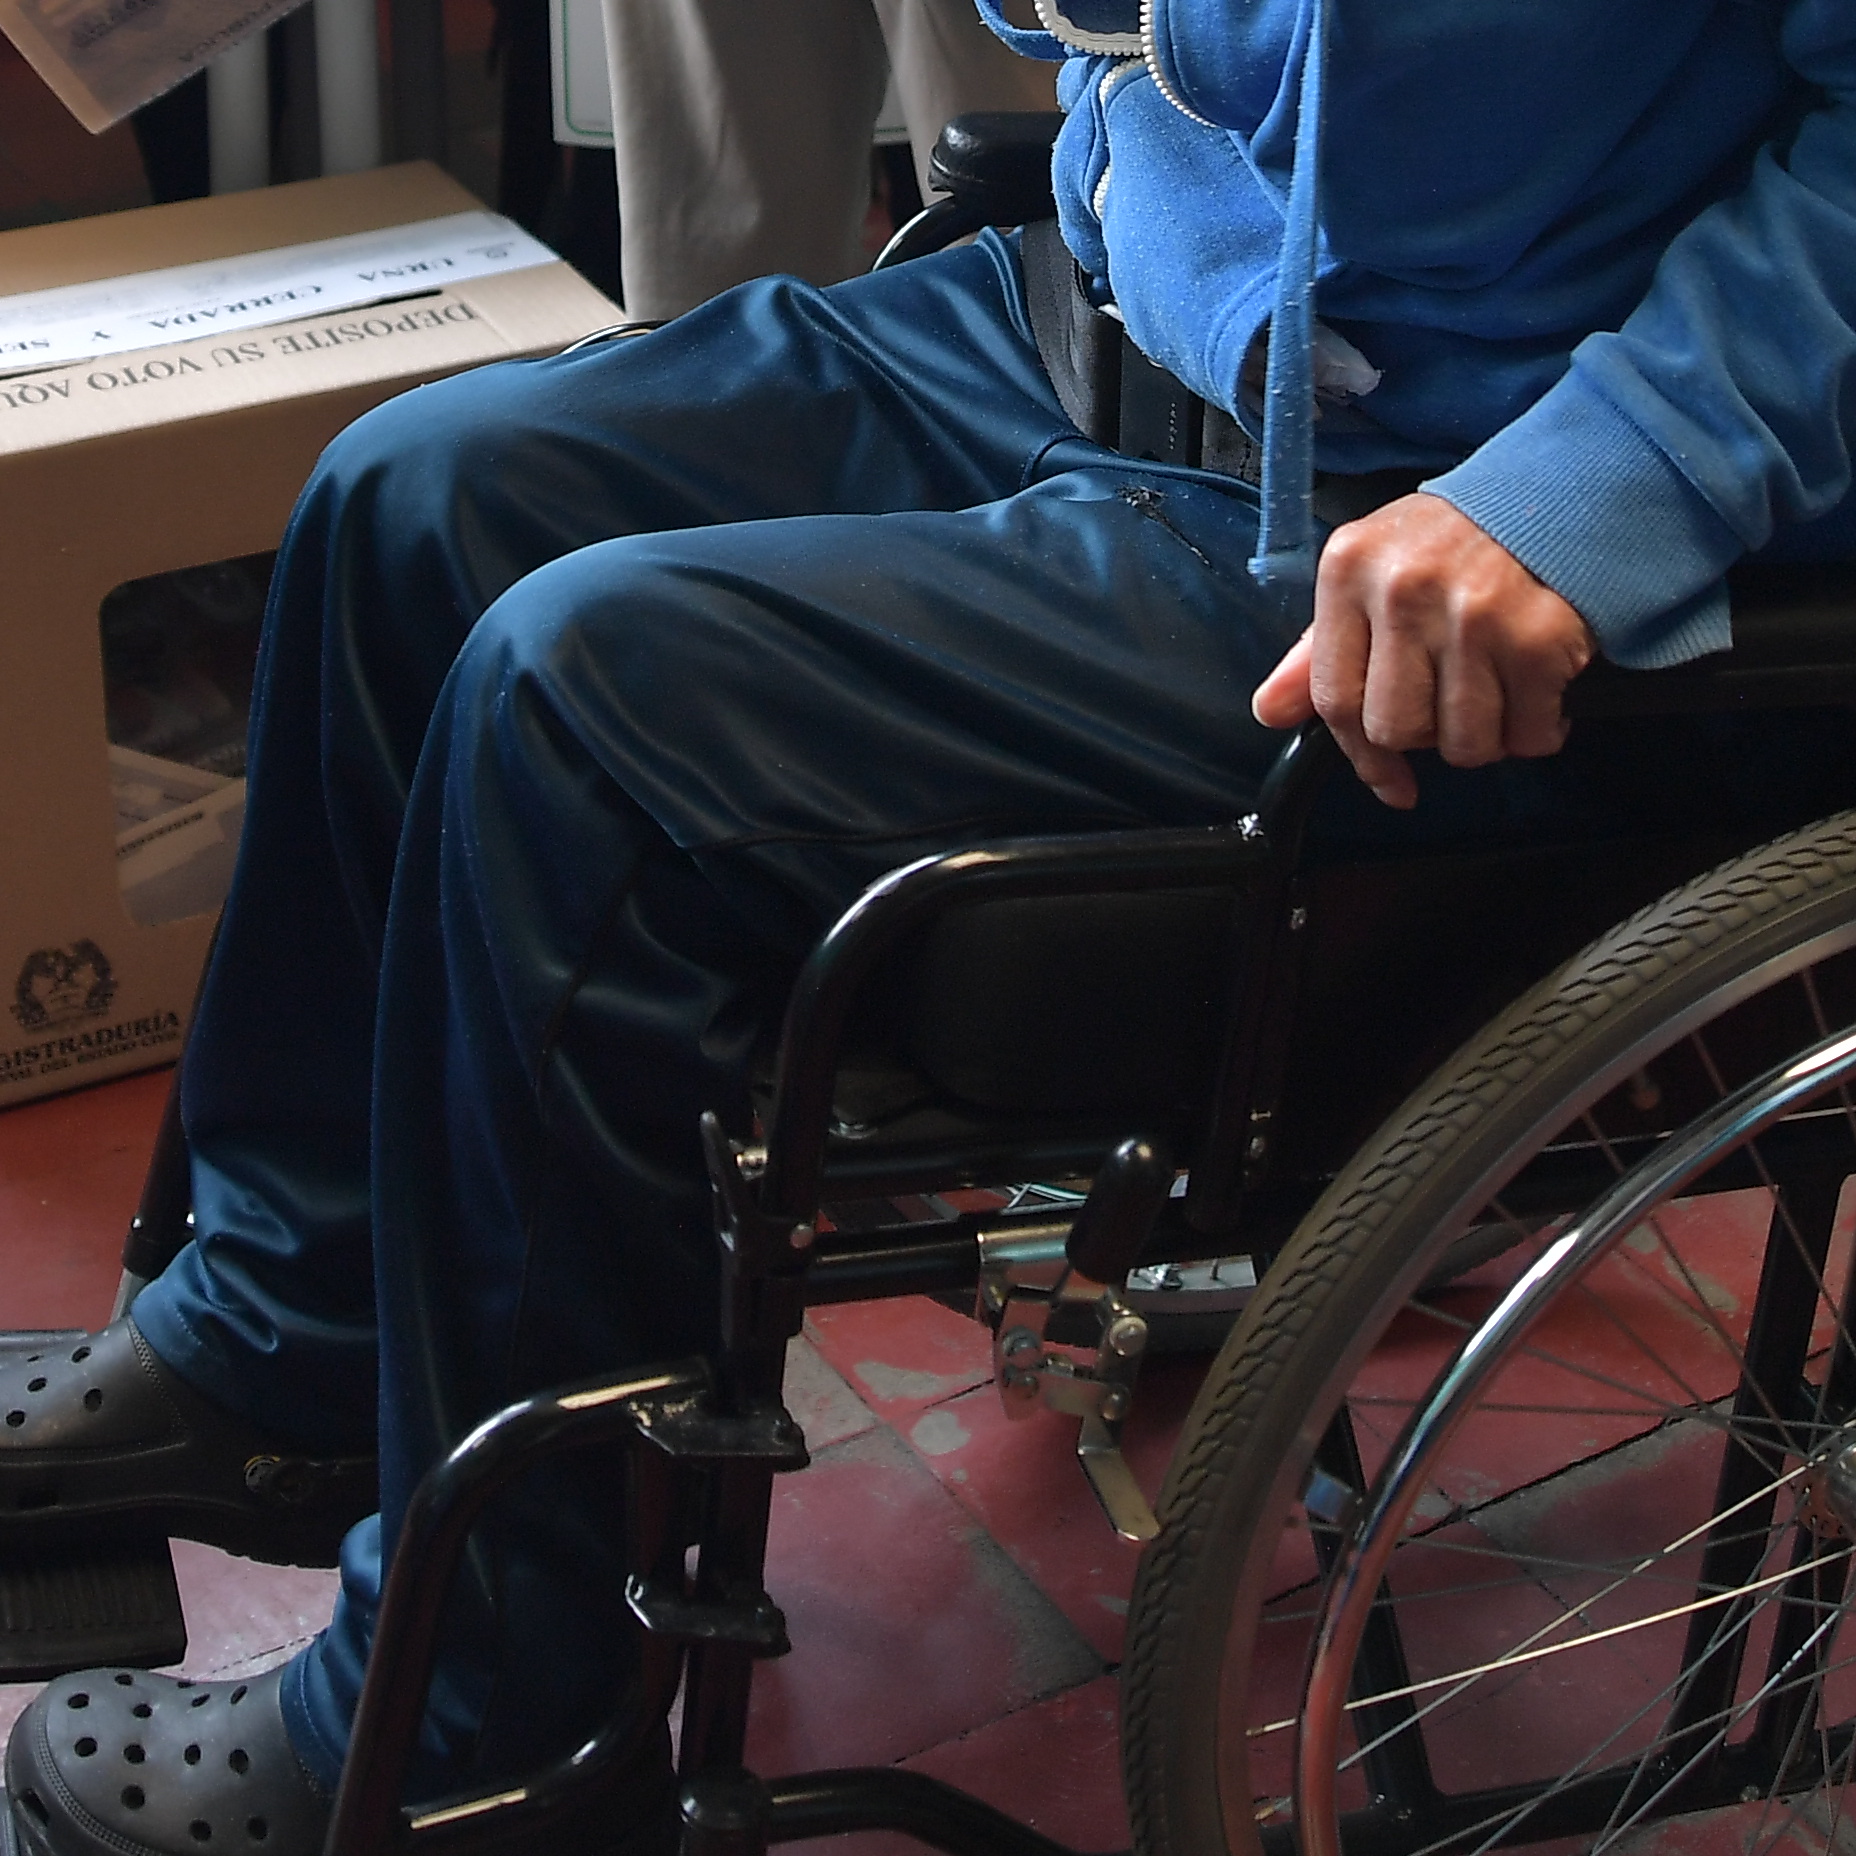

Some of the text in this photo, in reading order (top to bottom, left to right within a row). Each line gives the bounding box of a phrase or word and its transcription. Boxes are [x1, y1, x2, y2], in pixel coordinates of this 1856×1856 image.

[356, 256, 455, 283] URNA
[148, 284, 324, 330] CERRADA
[91, 330, 112, 342] Y
[281, 302, 479, 357] DEPOSITE
[211, 342, 267, 368] SU
[87, 356, 203, 392] VOTO
